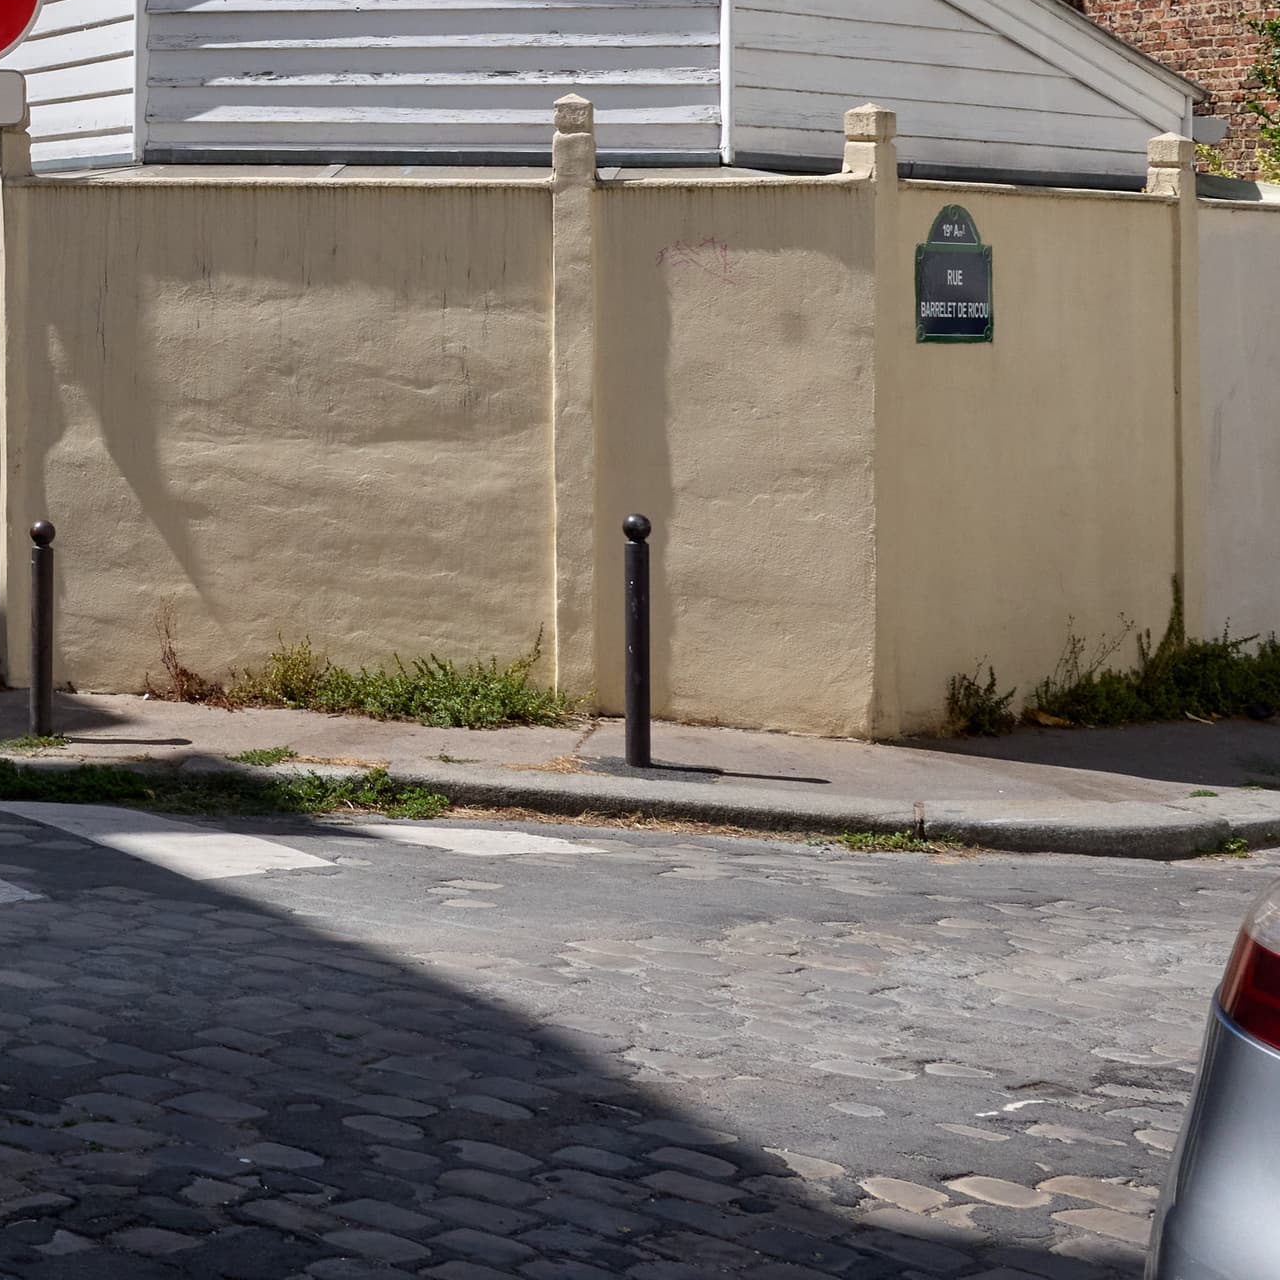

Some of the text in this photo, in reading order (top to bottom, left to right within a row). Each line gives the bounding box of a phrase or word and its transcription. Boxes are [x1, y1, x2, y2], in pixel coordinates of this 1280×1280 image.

[947, 269, 964, 286] RUE
[920, 301, 989, 319] BARRELET DE RICOU
